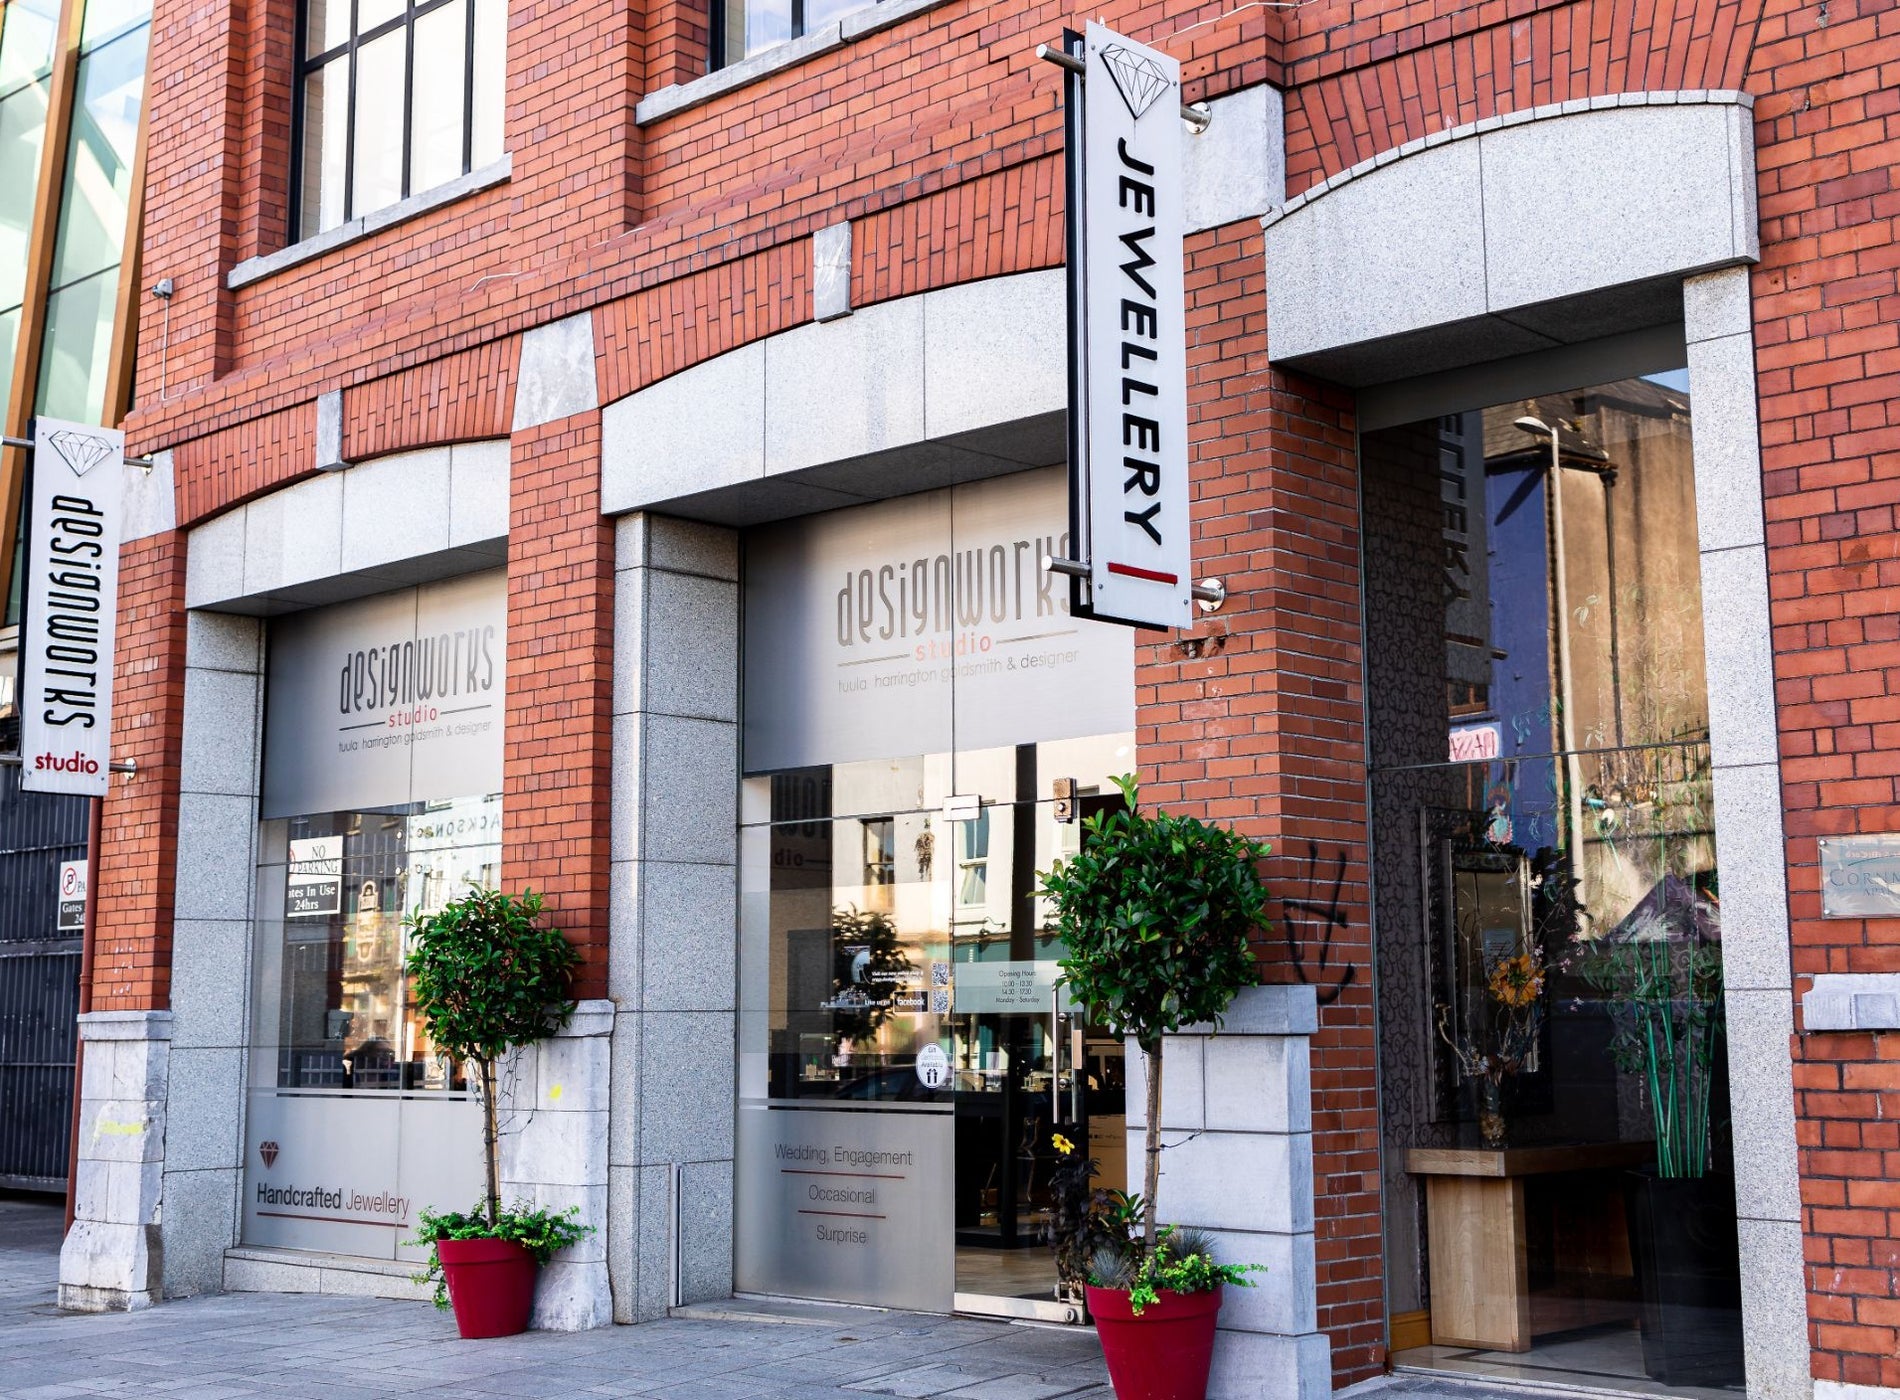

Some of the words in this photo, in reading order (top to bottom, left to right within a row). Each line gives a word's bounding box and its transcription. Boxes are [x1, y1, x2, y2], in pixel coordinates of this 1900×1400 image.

[1117, 136, 1162, 546] JEWELLERY
[44, 494, 104, 730] designworks
[915, 632, 991, 661] studio
[340, 625, 494, 714] designworks
[838, 679, 867, 693] tuula
[874, 670, 936, 688] harrington
[941, 658, 1002, 682] goldsmith
[1007, 658, 1017, 670] &
[1020, 650, 1079, 669] designer
[389, 705, 437, 727] studio
[338, 741, 358, 752] tuula
[363, 734, 402, 749] harrington
[404, 727, 444, 745] goldsmith
[446, 725, 453, 735] &
[455, 721, 492, 736] designer
[35, 751, 99, 775] studio
[312, 845, 326, 859] NO
[298, 859, 338, 874] PARKING
[307, 886, 316, 896] In
[320, 884, 335, 895] Use
[62, 903, 82, 913] Gates
[294, 898, 319, 910] 24hrs
[999, 970, 1020, 978] Opening
[896, 998, 924, 1006] facebook
[774, 1143, 830, 1164] Wedding,
[834, 1146, 912, 1167] Engagement
[257, 1182, 341, 1209] Handcrafted
[346, 1189, 409, 1219] Jewellery
[808, 1184, 875, 1204] Occasional
[816, 1225, 867, 1245] Surprise
